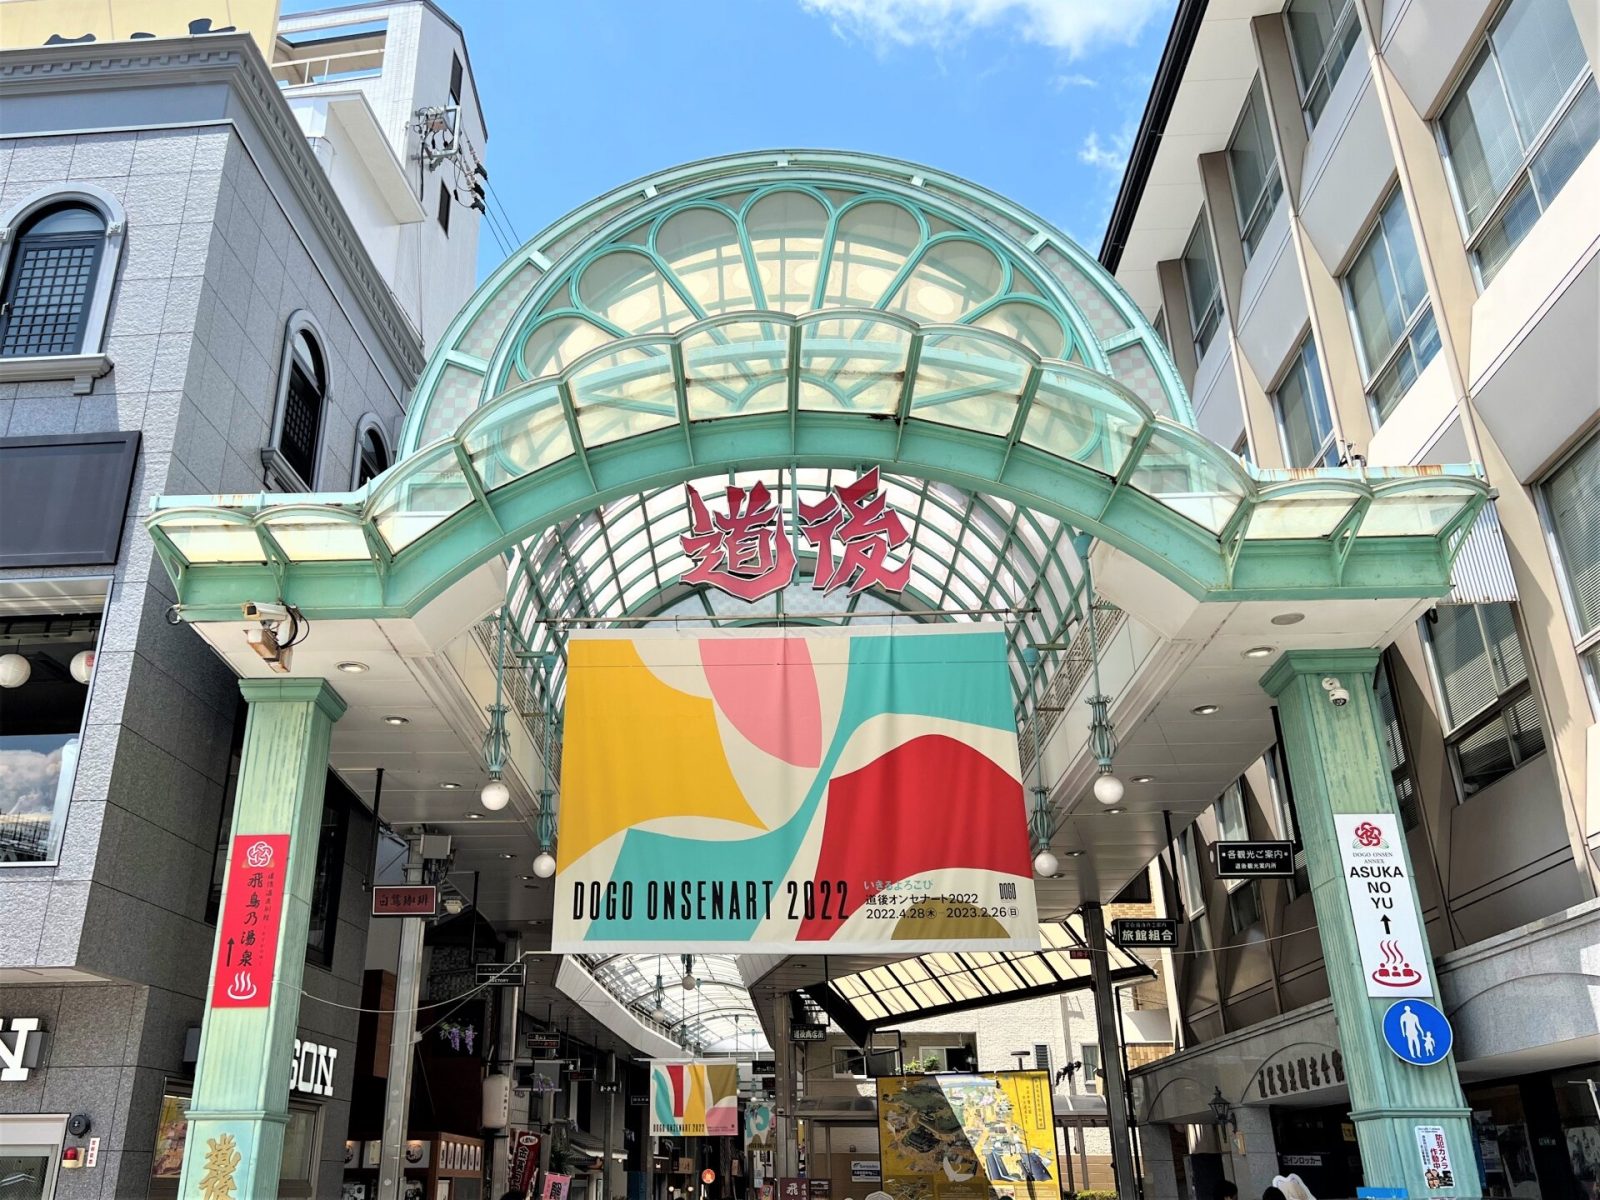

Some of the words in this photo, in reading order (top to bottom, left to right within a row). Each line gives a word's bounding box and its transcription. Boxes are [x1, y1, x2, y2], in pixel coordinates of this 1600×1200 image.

[680, 465, 914, 604] 道後
[1350, 866, 1404, 878] ASUKA
[863, 879, 933, 891] いきるよろこび
[1367, 881, 1391, 893] NO
[572, 880, 633, 920] DOGO
[647, 880, 773, 920] ONSENART
[787, 880, 850, 920] 2022
[865, 893, 979, 905] 道後オンセナート2022
[1371, 897, 1394, 909] YU
[238, 872, 264, 967] 飛鳥乃湯泉
[1121, 929, 1173, 941] 旅館組合
[1435, 1134, 1448, 1169] 防犯カメラ
[1430, 1148, 1441, 1169] 作動中
